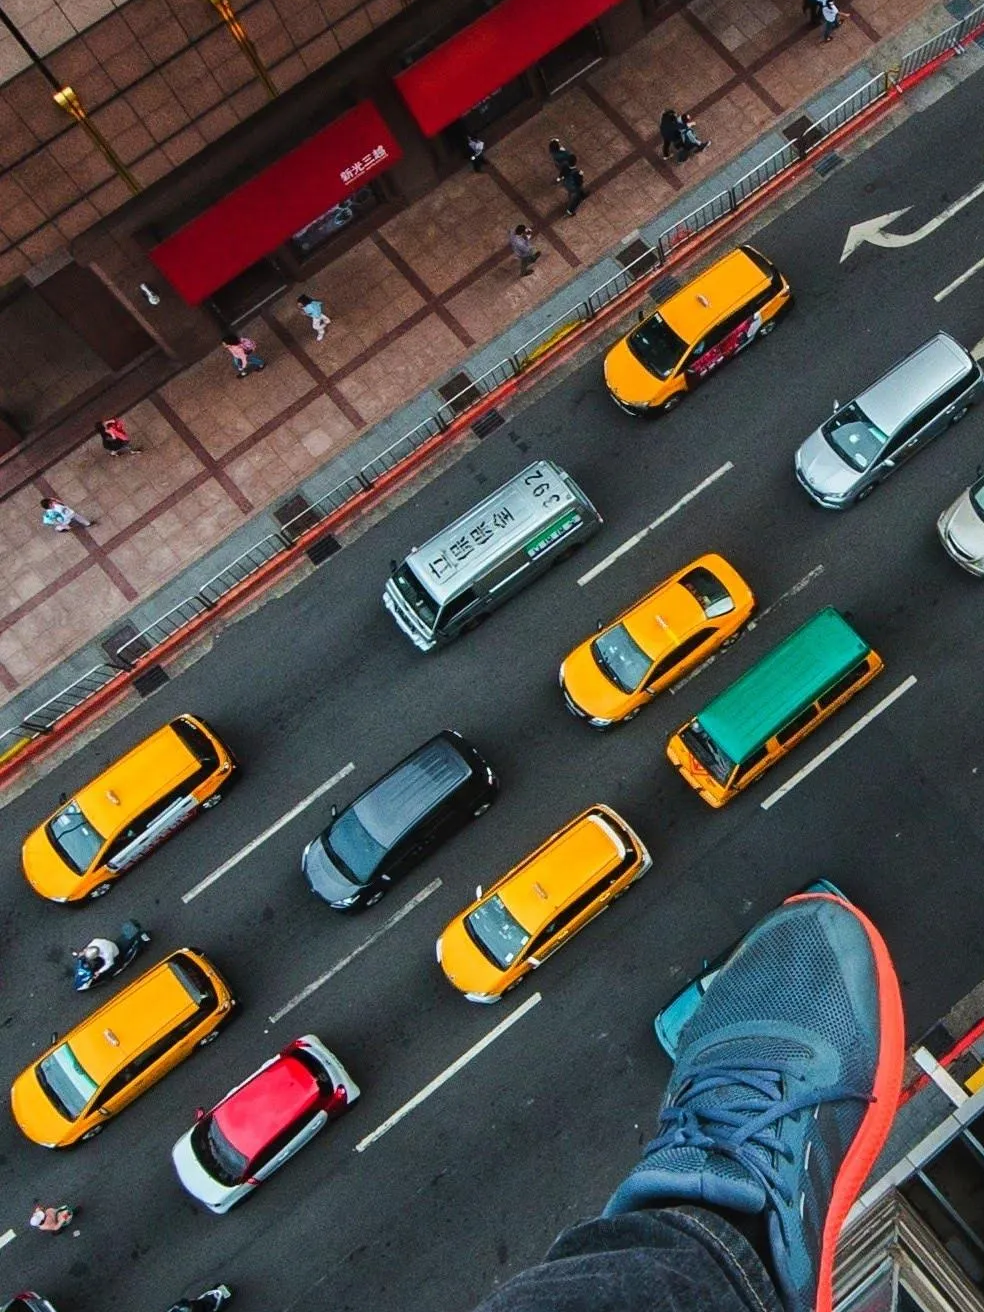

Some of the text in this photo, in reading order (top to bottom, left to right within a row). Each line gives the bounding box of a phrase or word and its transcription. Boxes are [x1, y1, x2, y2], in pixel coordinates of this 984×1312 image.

[340, 144, 387, 182] 新光三越
[524, 470, 560, 508] 392
